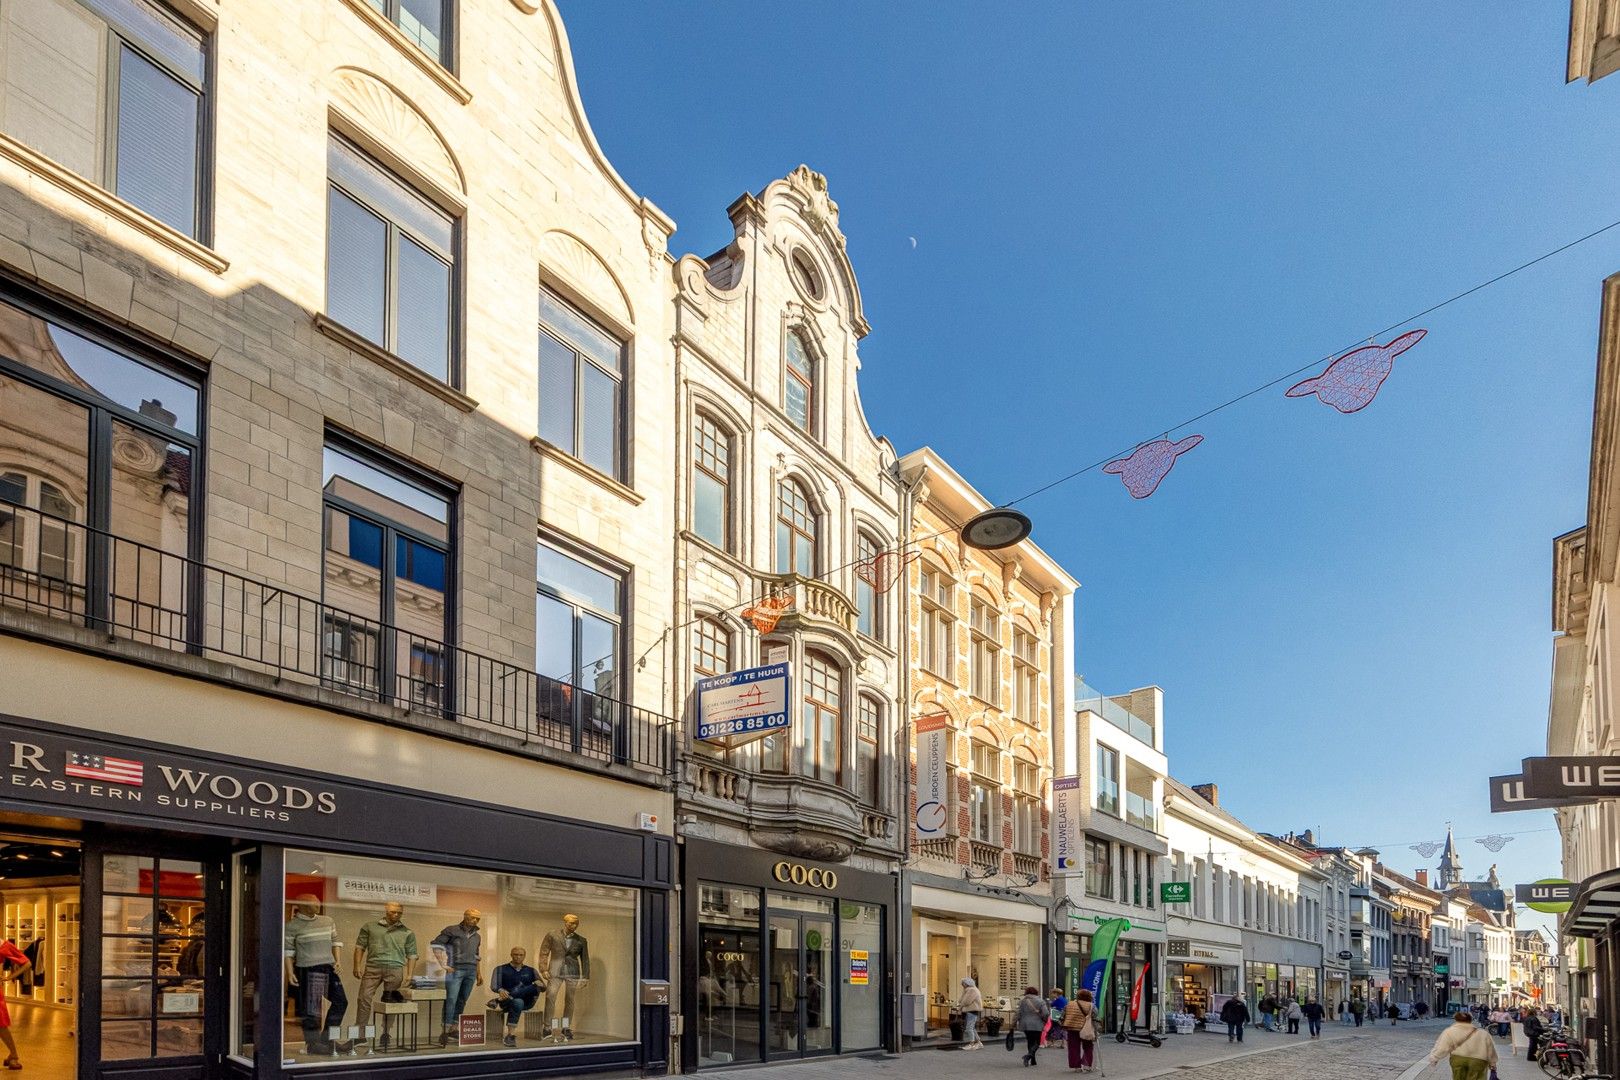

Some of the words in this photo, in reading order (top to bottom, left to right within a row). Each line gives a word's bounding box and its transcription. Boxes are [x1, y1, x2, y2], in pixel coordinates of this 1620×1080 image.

[702, 681, 712, 689] TE
[713, 676, 738, 687] KOOP
[758, 667, 784, 678] HUUR
[701, 720, 743, 736] 03/226
[746, 717, 764, 729] 85
[767, 714, 785, 726] 00
[931, 733, 939, 771] CEUPPENS
[931, 770, 939, 800] JEROEN
[1055, 782, 1078, 790] OPTIEK
[1561, 766, 1620, 787] WE
[157, 765, 337, 814] WOODS
[157, 795, 290, 821] SUPPLIERS
[1058, 792, 1067, 855] NAUWELAERTS
[1067, 818, 1075, 855] OPTICIENS
[774, 861, 838, 890] COCO
[1531, 887, 1570, 898] WE
[716, 952, 745, 961] COCO
[657, 994, 668, 1003] 34
